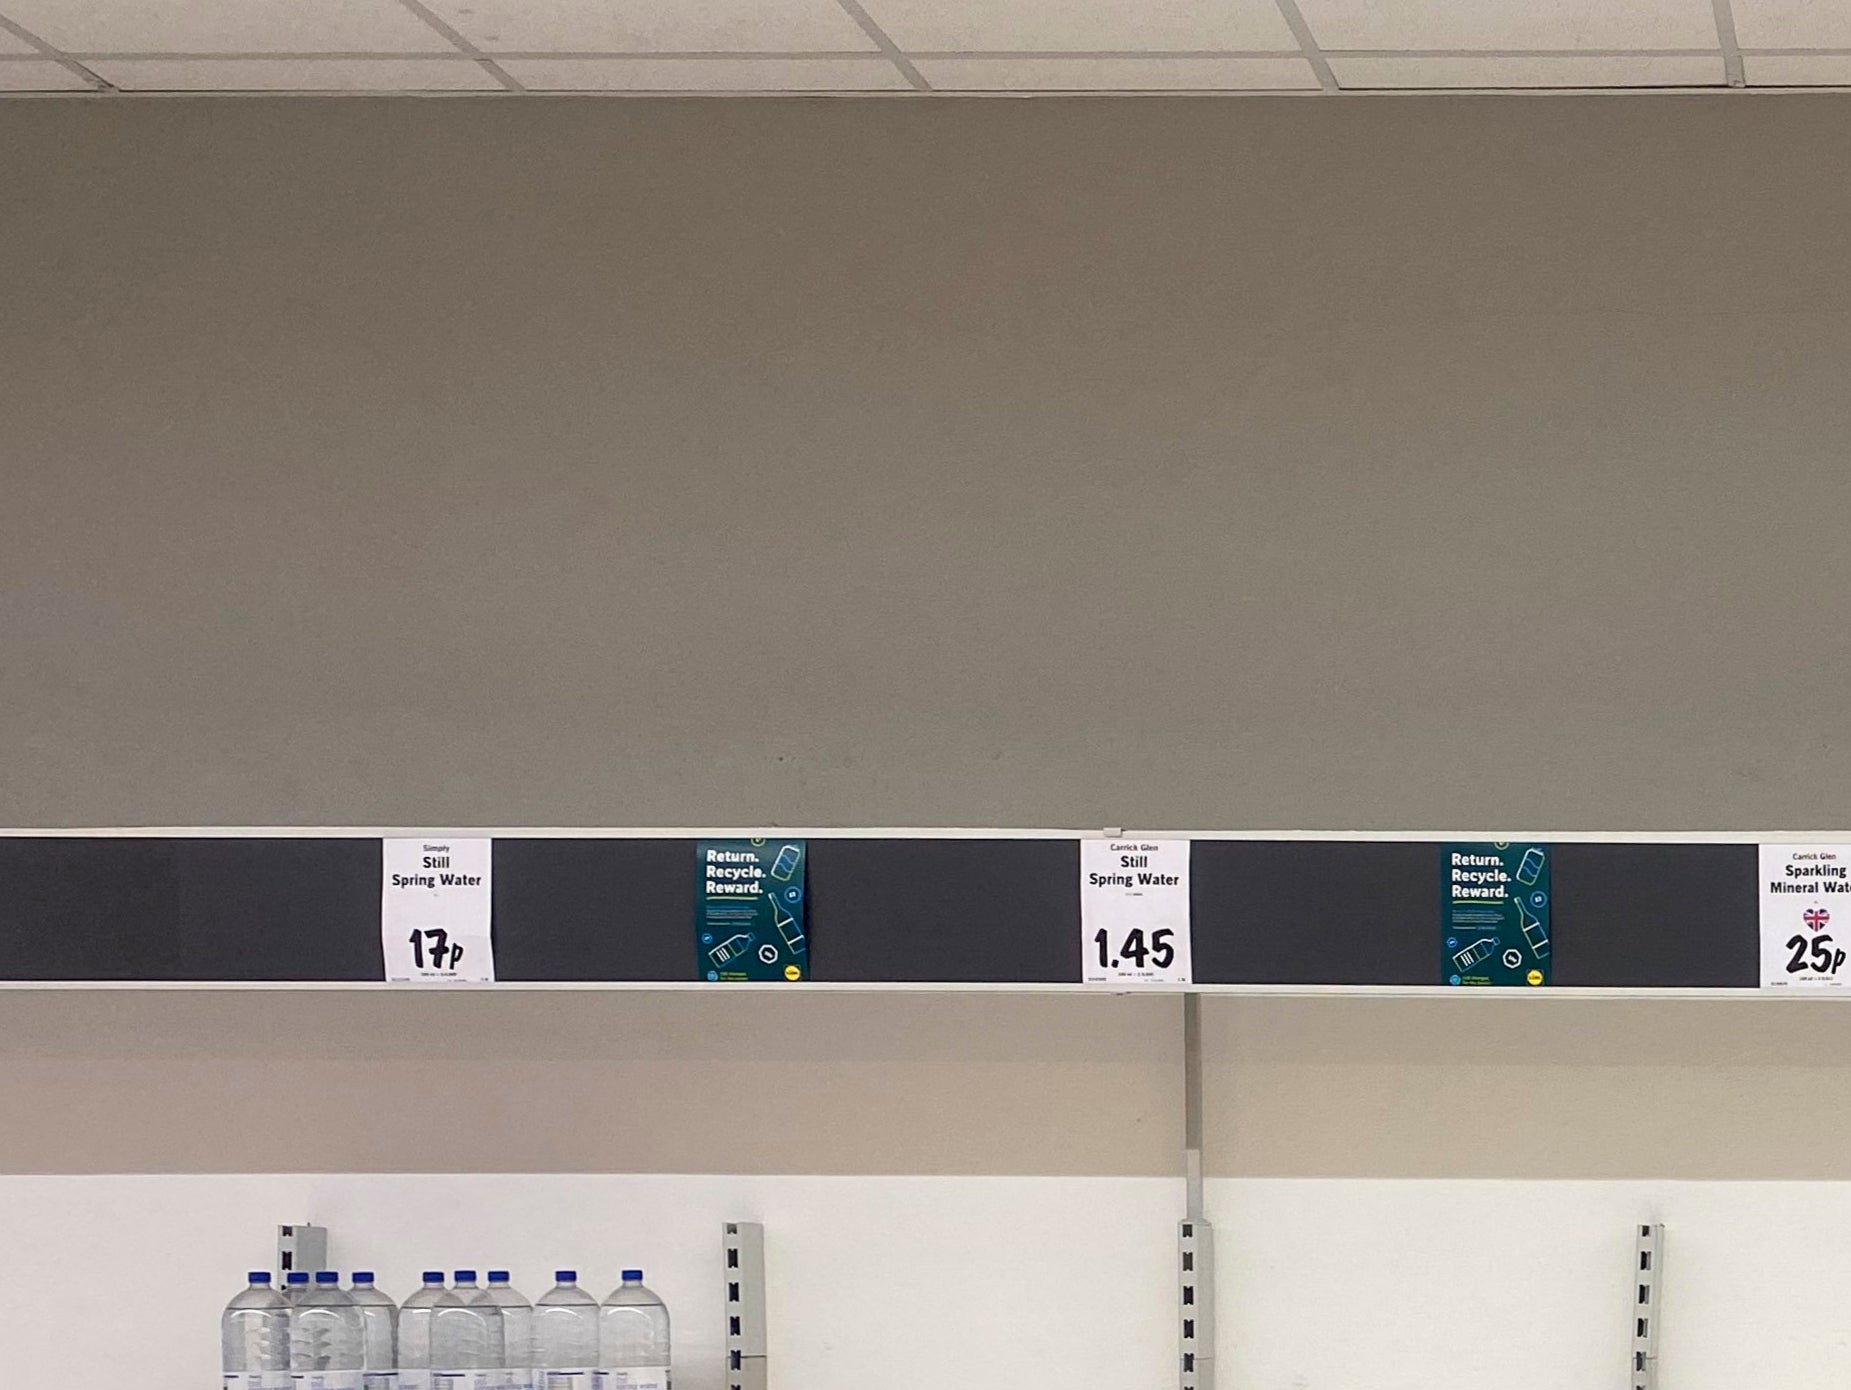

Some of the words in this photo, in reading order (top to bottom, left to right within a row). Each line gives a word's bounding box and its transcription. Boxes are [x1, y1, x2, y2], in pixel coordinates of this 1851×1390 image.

[1110, 844, 1138, 852] Carrick
[1140, 844, 1158, 852] Glen
[422, 856, 450, 868] Still
[706, 849, 760, 862] Return.
[1120, 855, 1148, 868] Still
[1451, 852, 1504, 866] Return.
[706, 865, 766, 880] Recycle.
[1451, 869, 1512, 884] Recycle.
[1785, 864, 1847, 879] Sparkling
[392, 874, 436, 888] Spring
[440, 874, 482, 886] Water
[706, 880, 763, 894] Reward.
[1089, 873, 1133, 888] Spring
[1138, 873, 1180, 886] Water
[1452, 884, 1509, 898] Reward.
[1770, 882, 1819, 894] Mineral
[409, 928, 464, 970] 17p
[1094, 928, 1174, 969] 1.45
[1786, 934, 1846, 975] 25p
